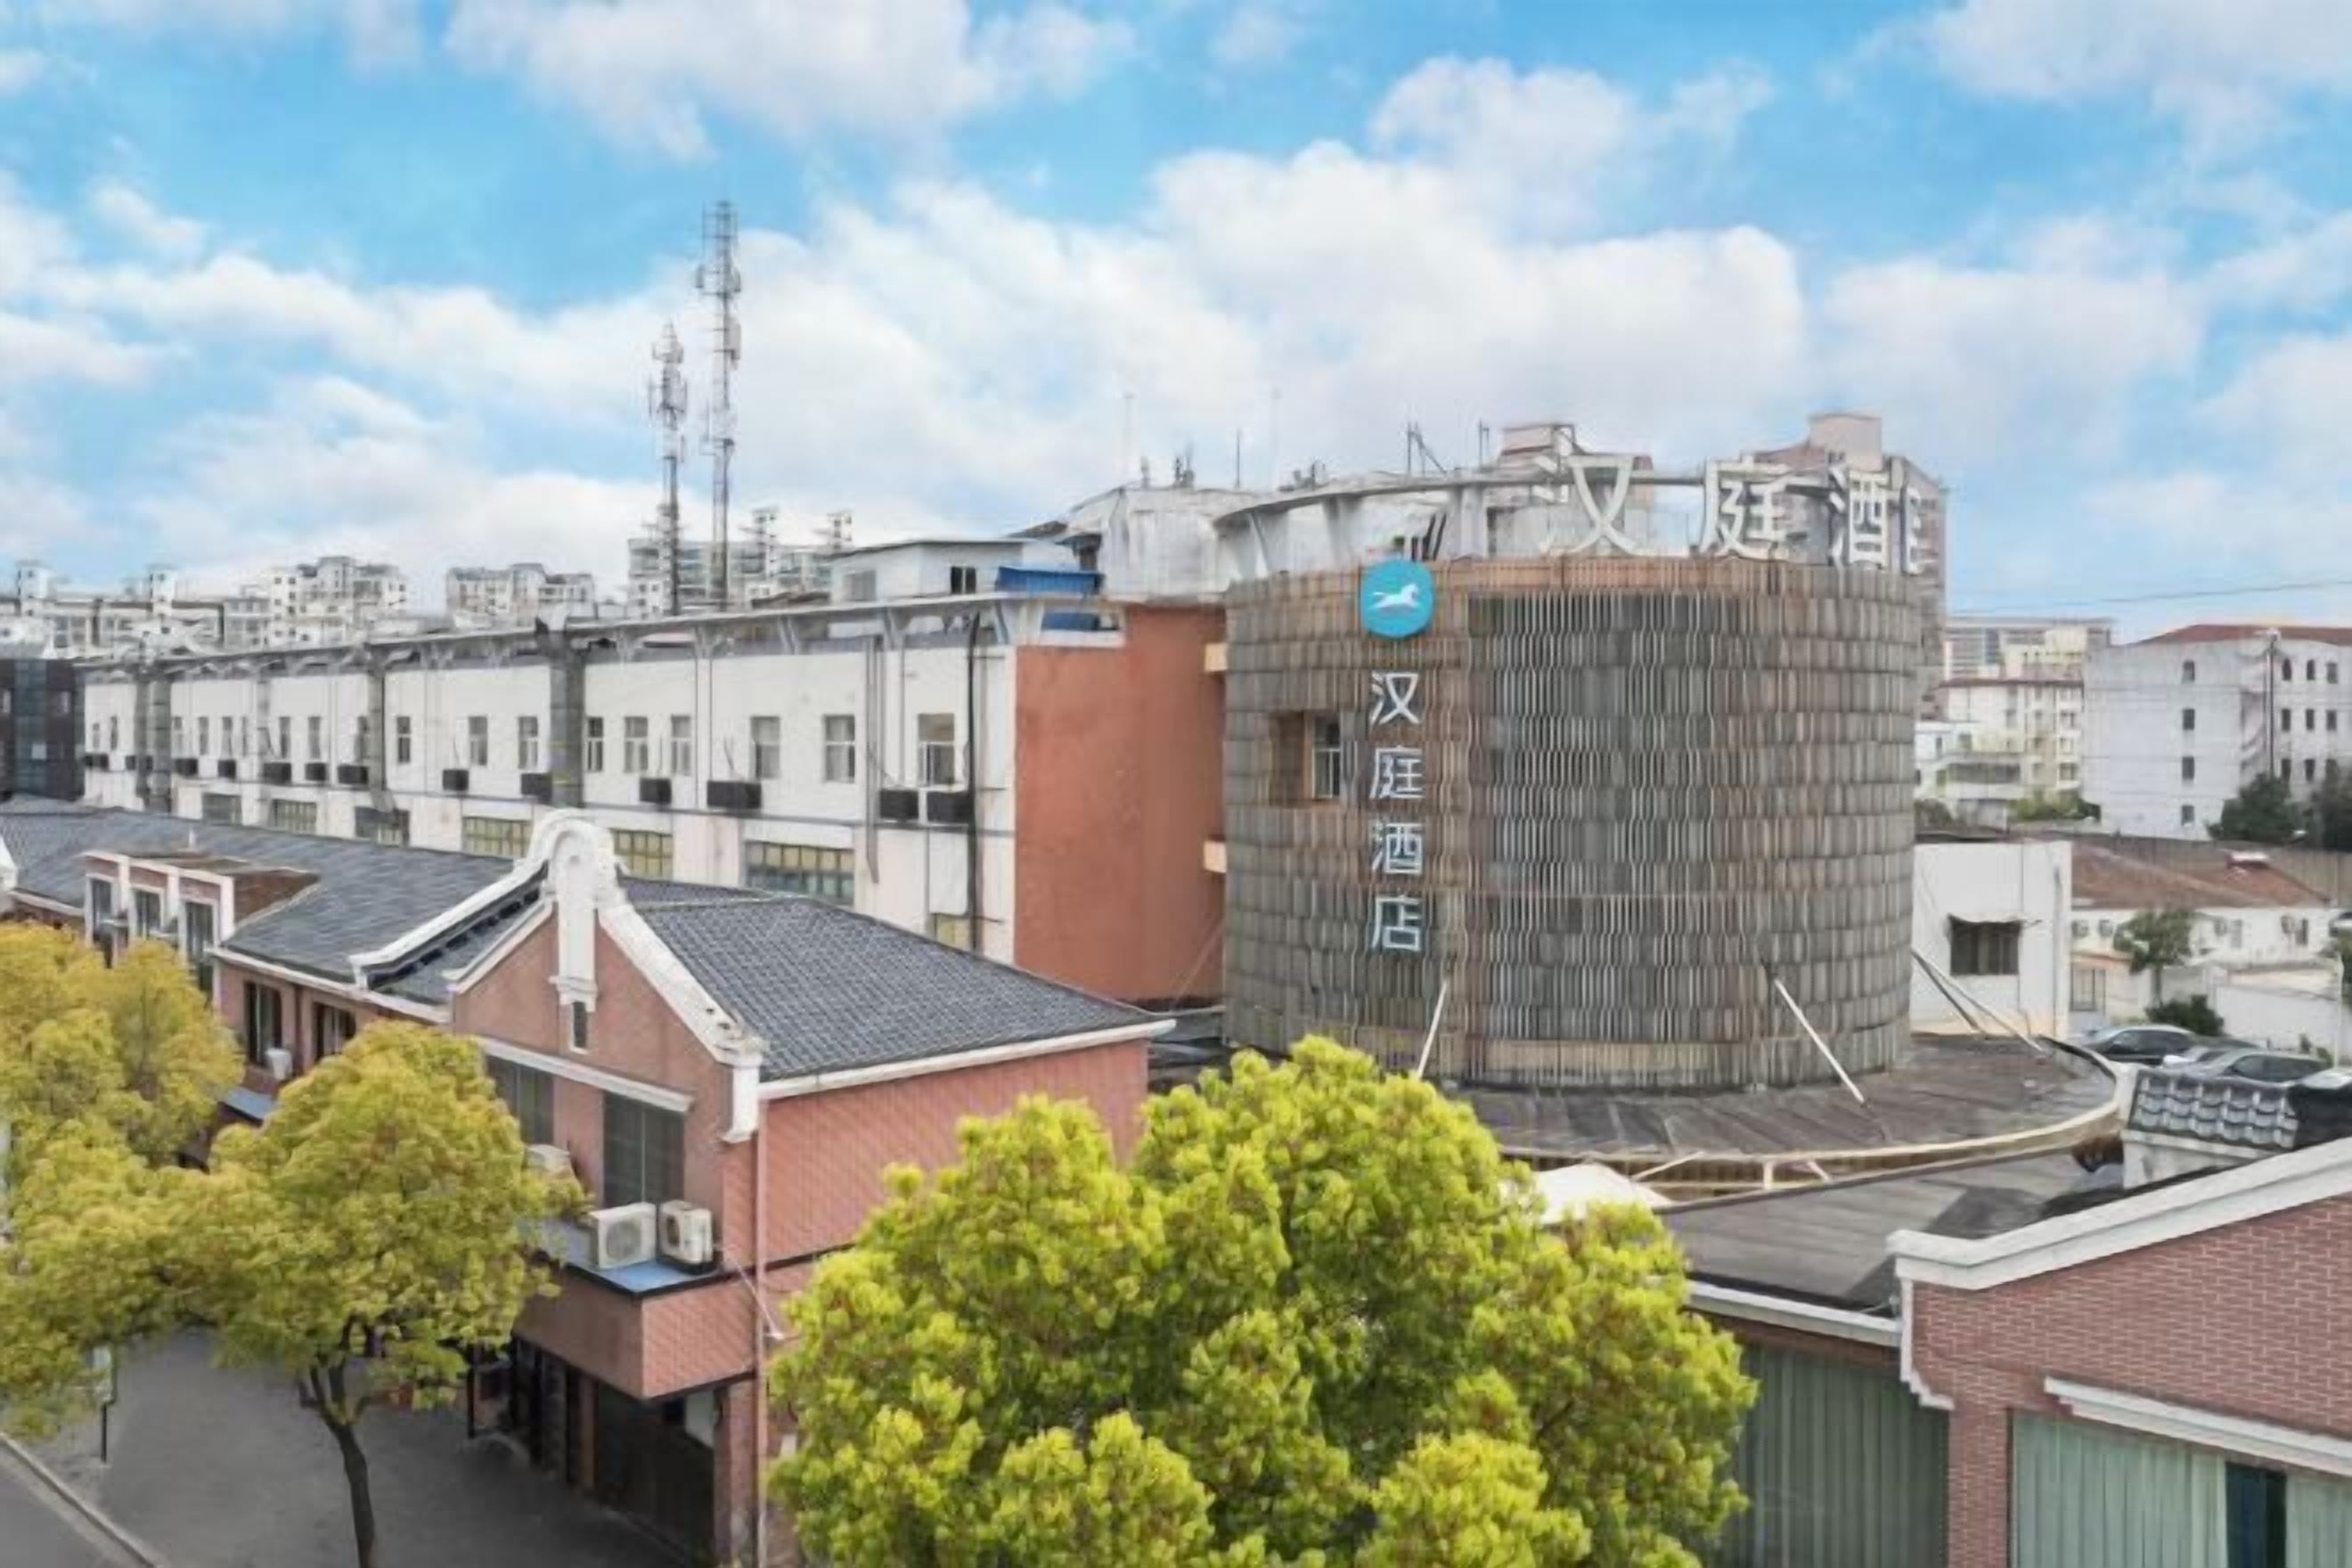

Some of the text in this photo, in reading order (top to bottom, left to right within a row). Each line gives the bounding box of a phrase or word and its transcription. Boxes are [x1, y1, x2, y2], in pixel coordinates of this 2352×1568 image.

[1532, 454, 1923, 575] 汉庭酒
[1369, 671, 1424, 952] 汉庭酒店
